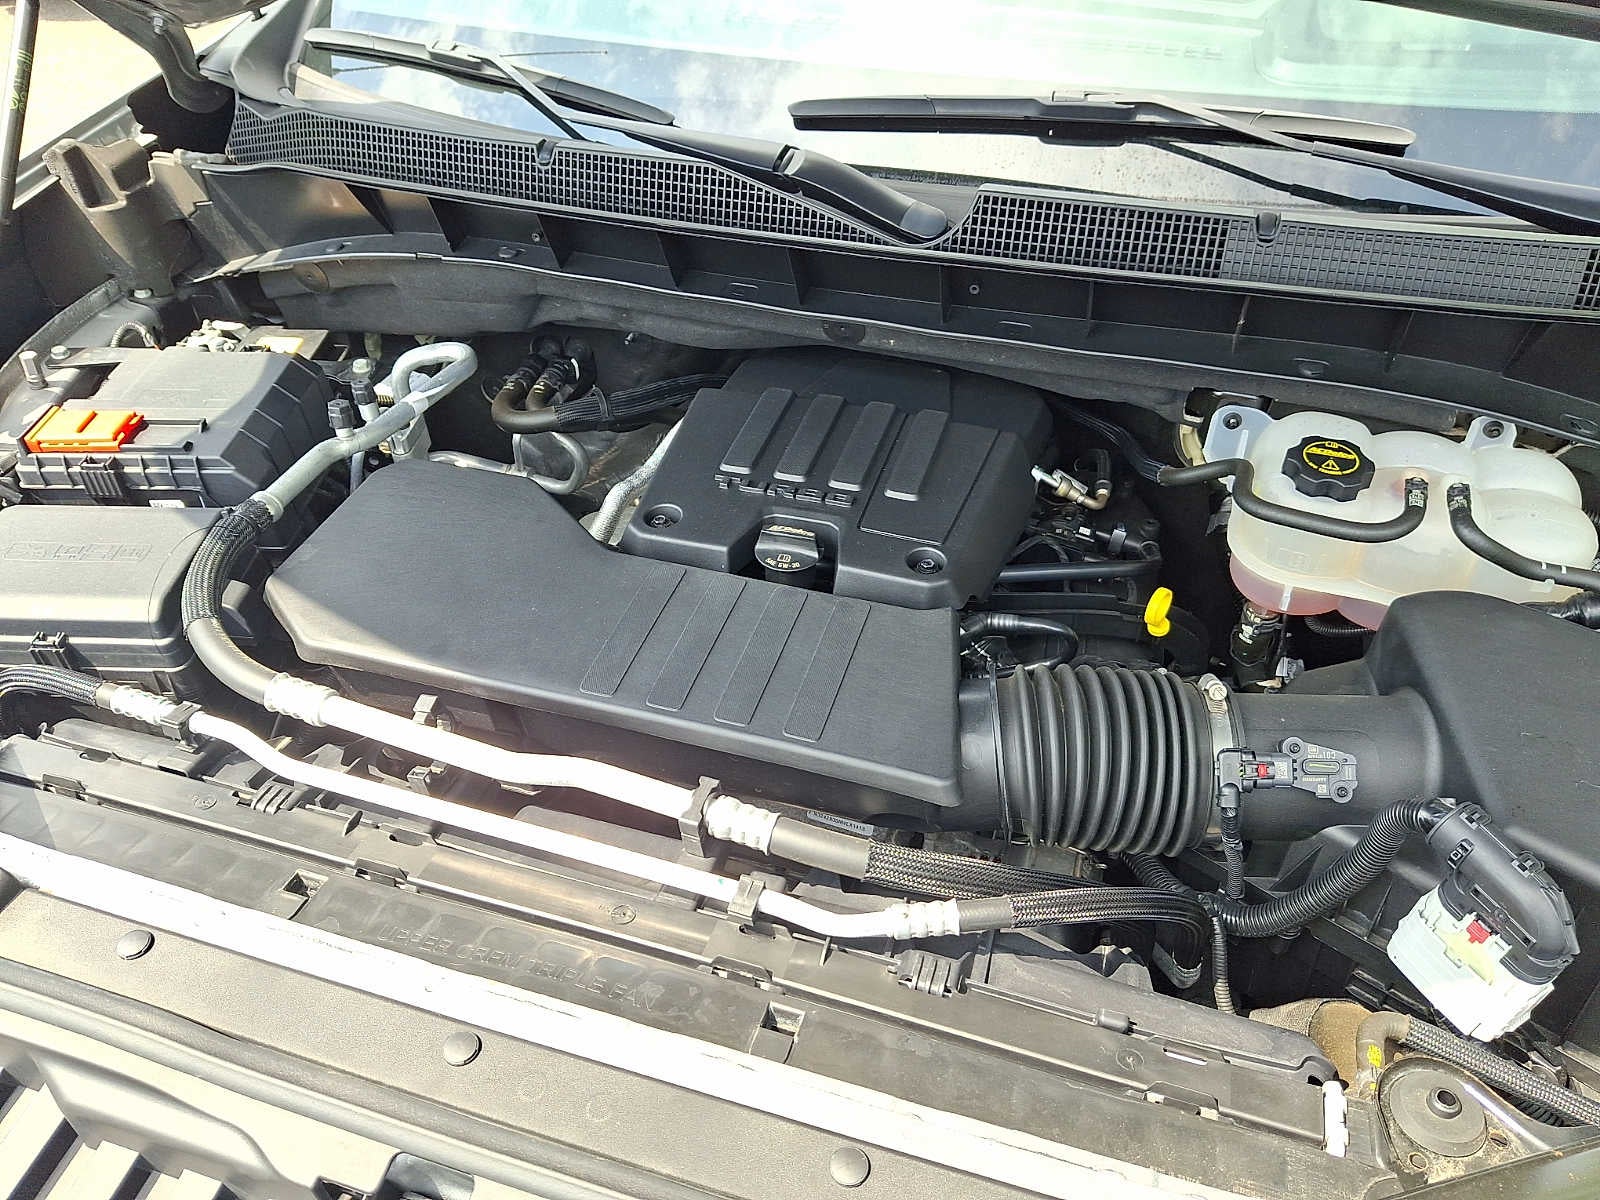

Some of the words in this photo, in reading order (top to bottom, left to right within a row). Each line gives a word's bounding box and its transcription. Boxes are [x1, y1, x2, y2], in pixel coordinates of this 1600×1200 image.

[714, 473, 855, 508] TURBO
[377, 924, 450, 954] UPPER
[527, 958, 605, 993] TRIPLE
[608, 982, 660, 1012] FAN
